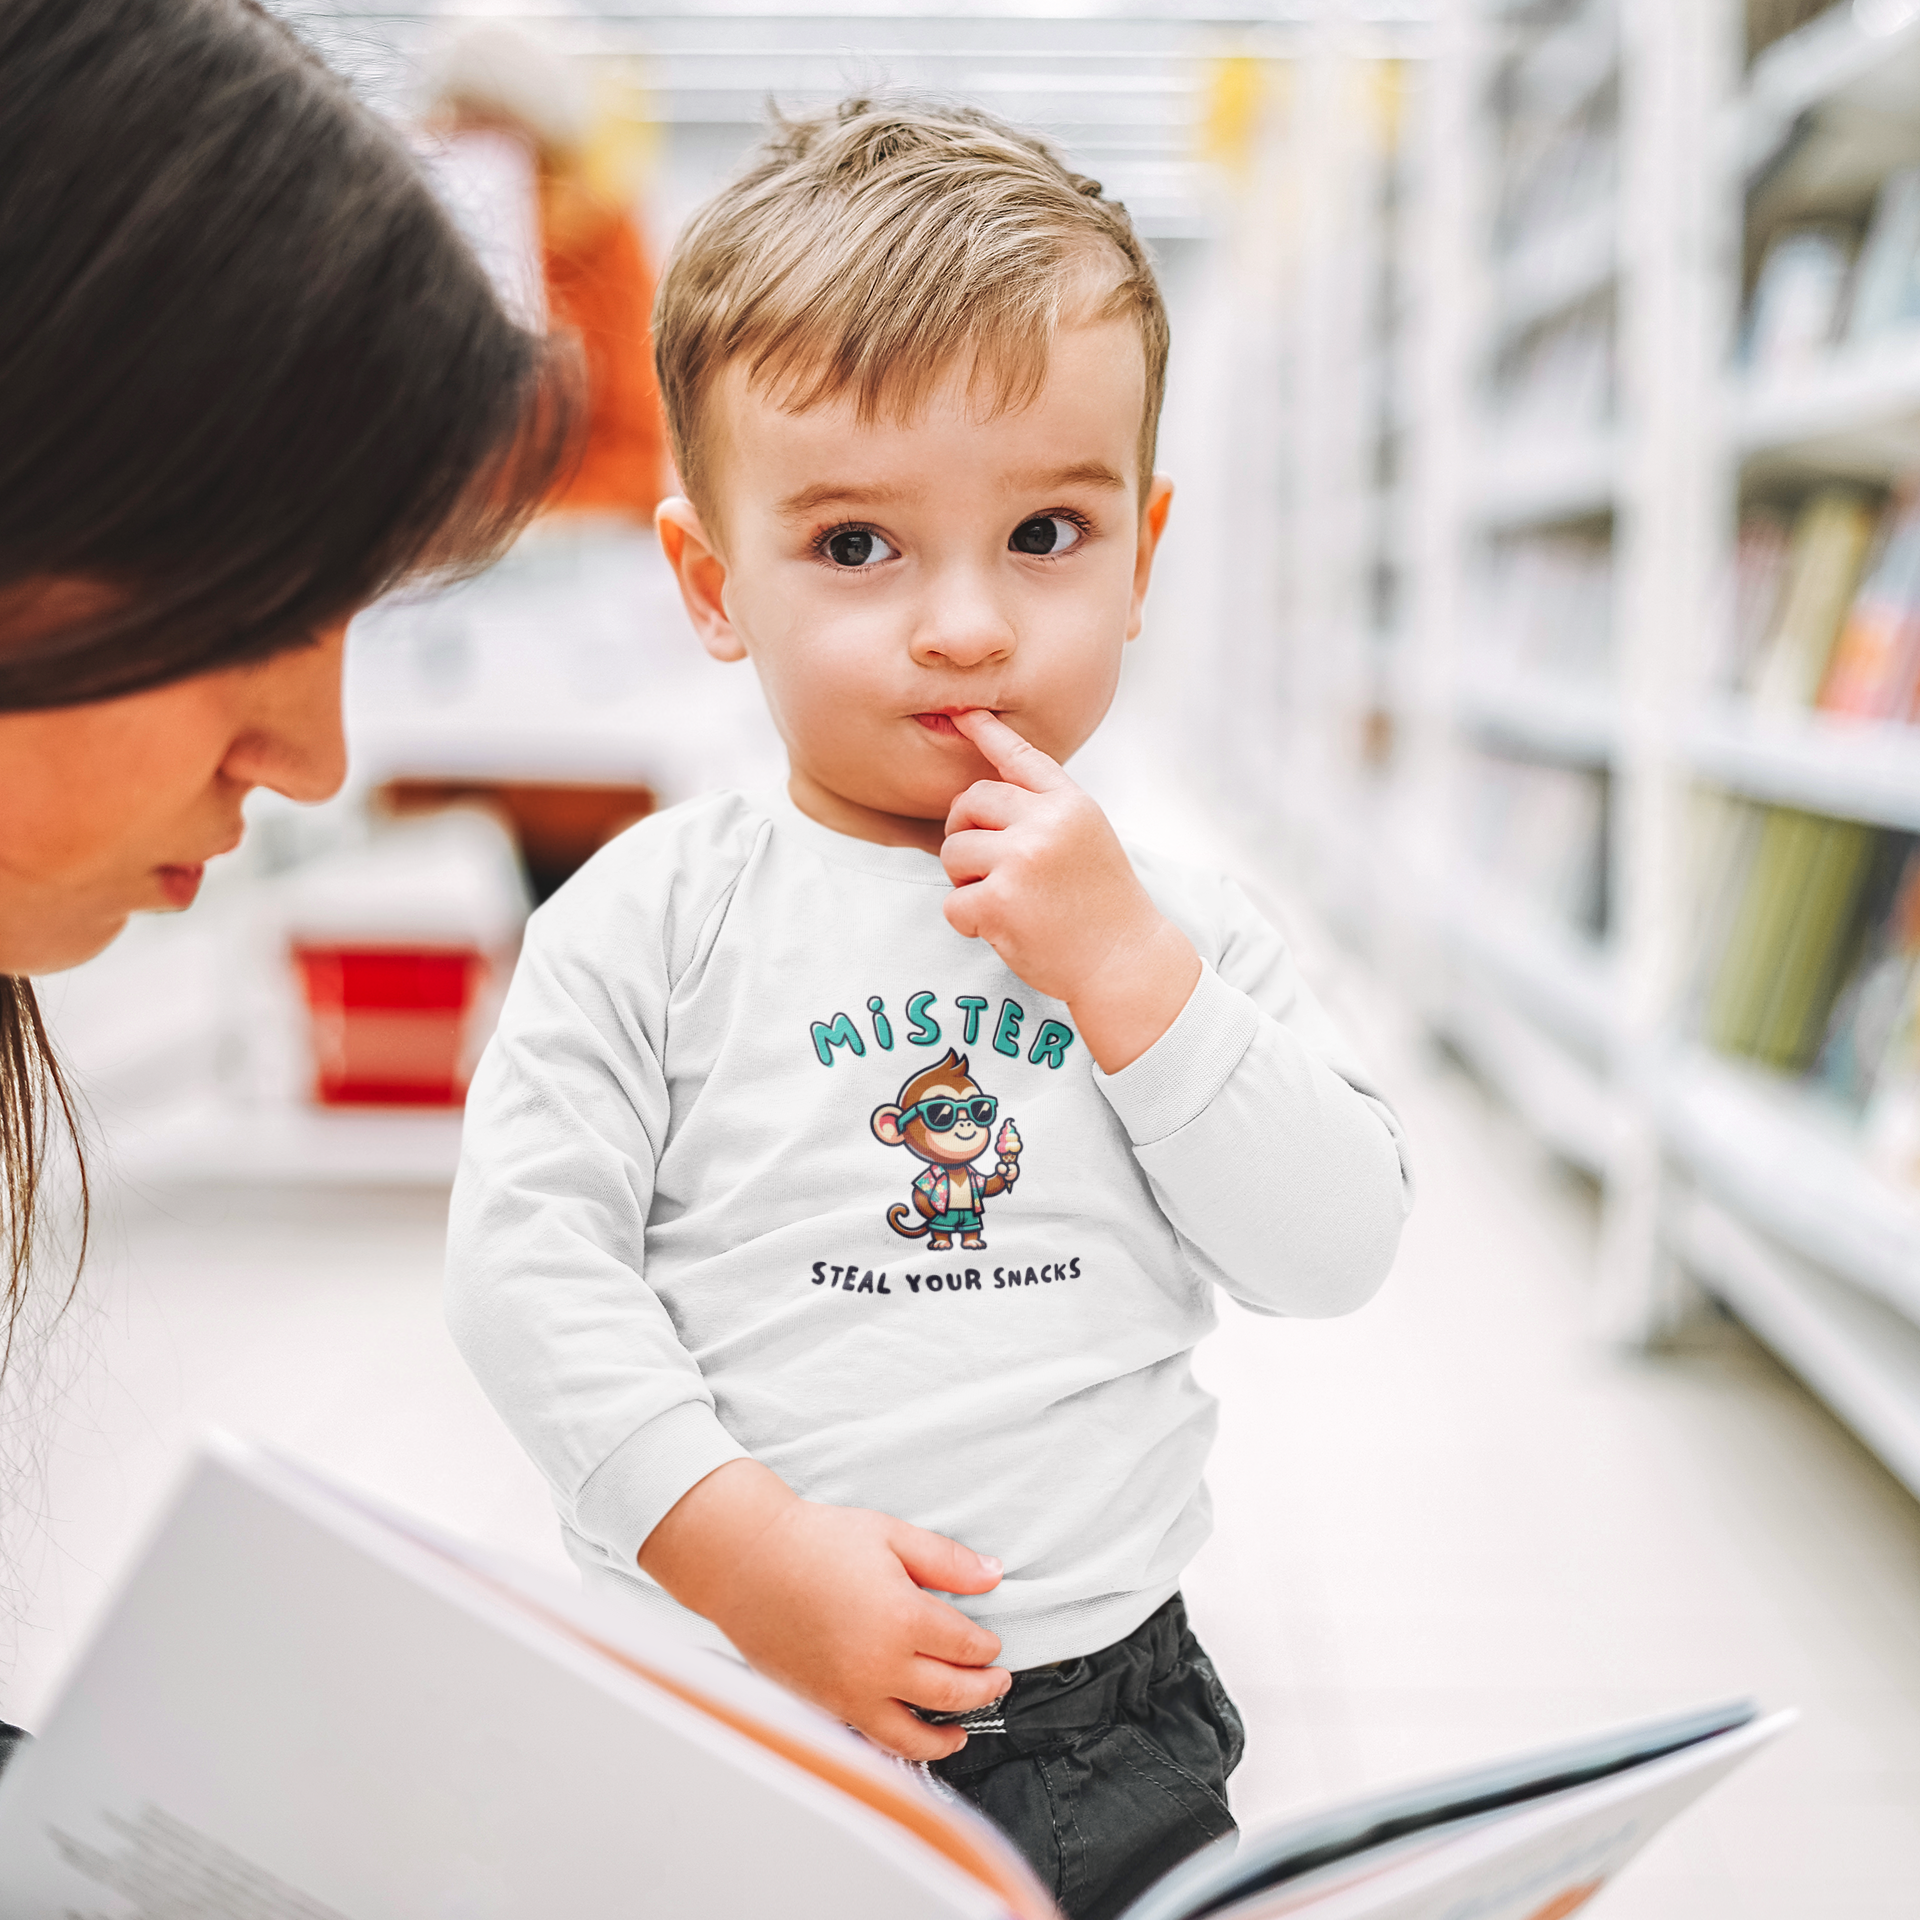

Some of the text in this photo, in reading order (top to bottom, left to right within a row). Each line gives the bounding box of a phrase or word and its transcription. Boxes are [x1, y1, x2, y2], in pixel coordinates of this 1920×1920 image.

[811, 1257, 1081, 1294] STEAL YOUR SNACKS
